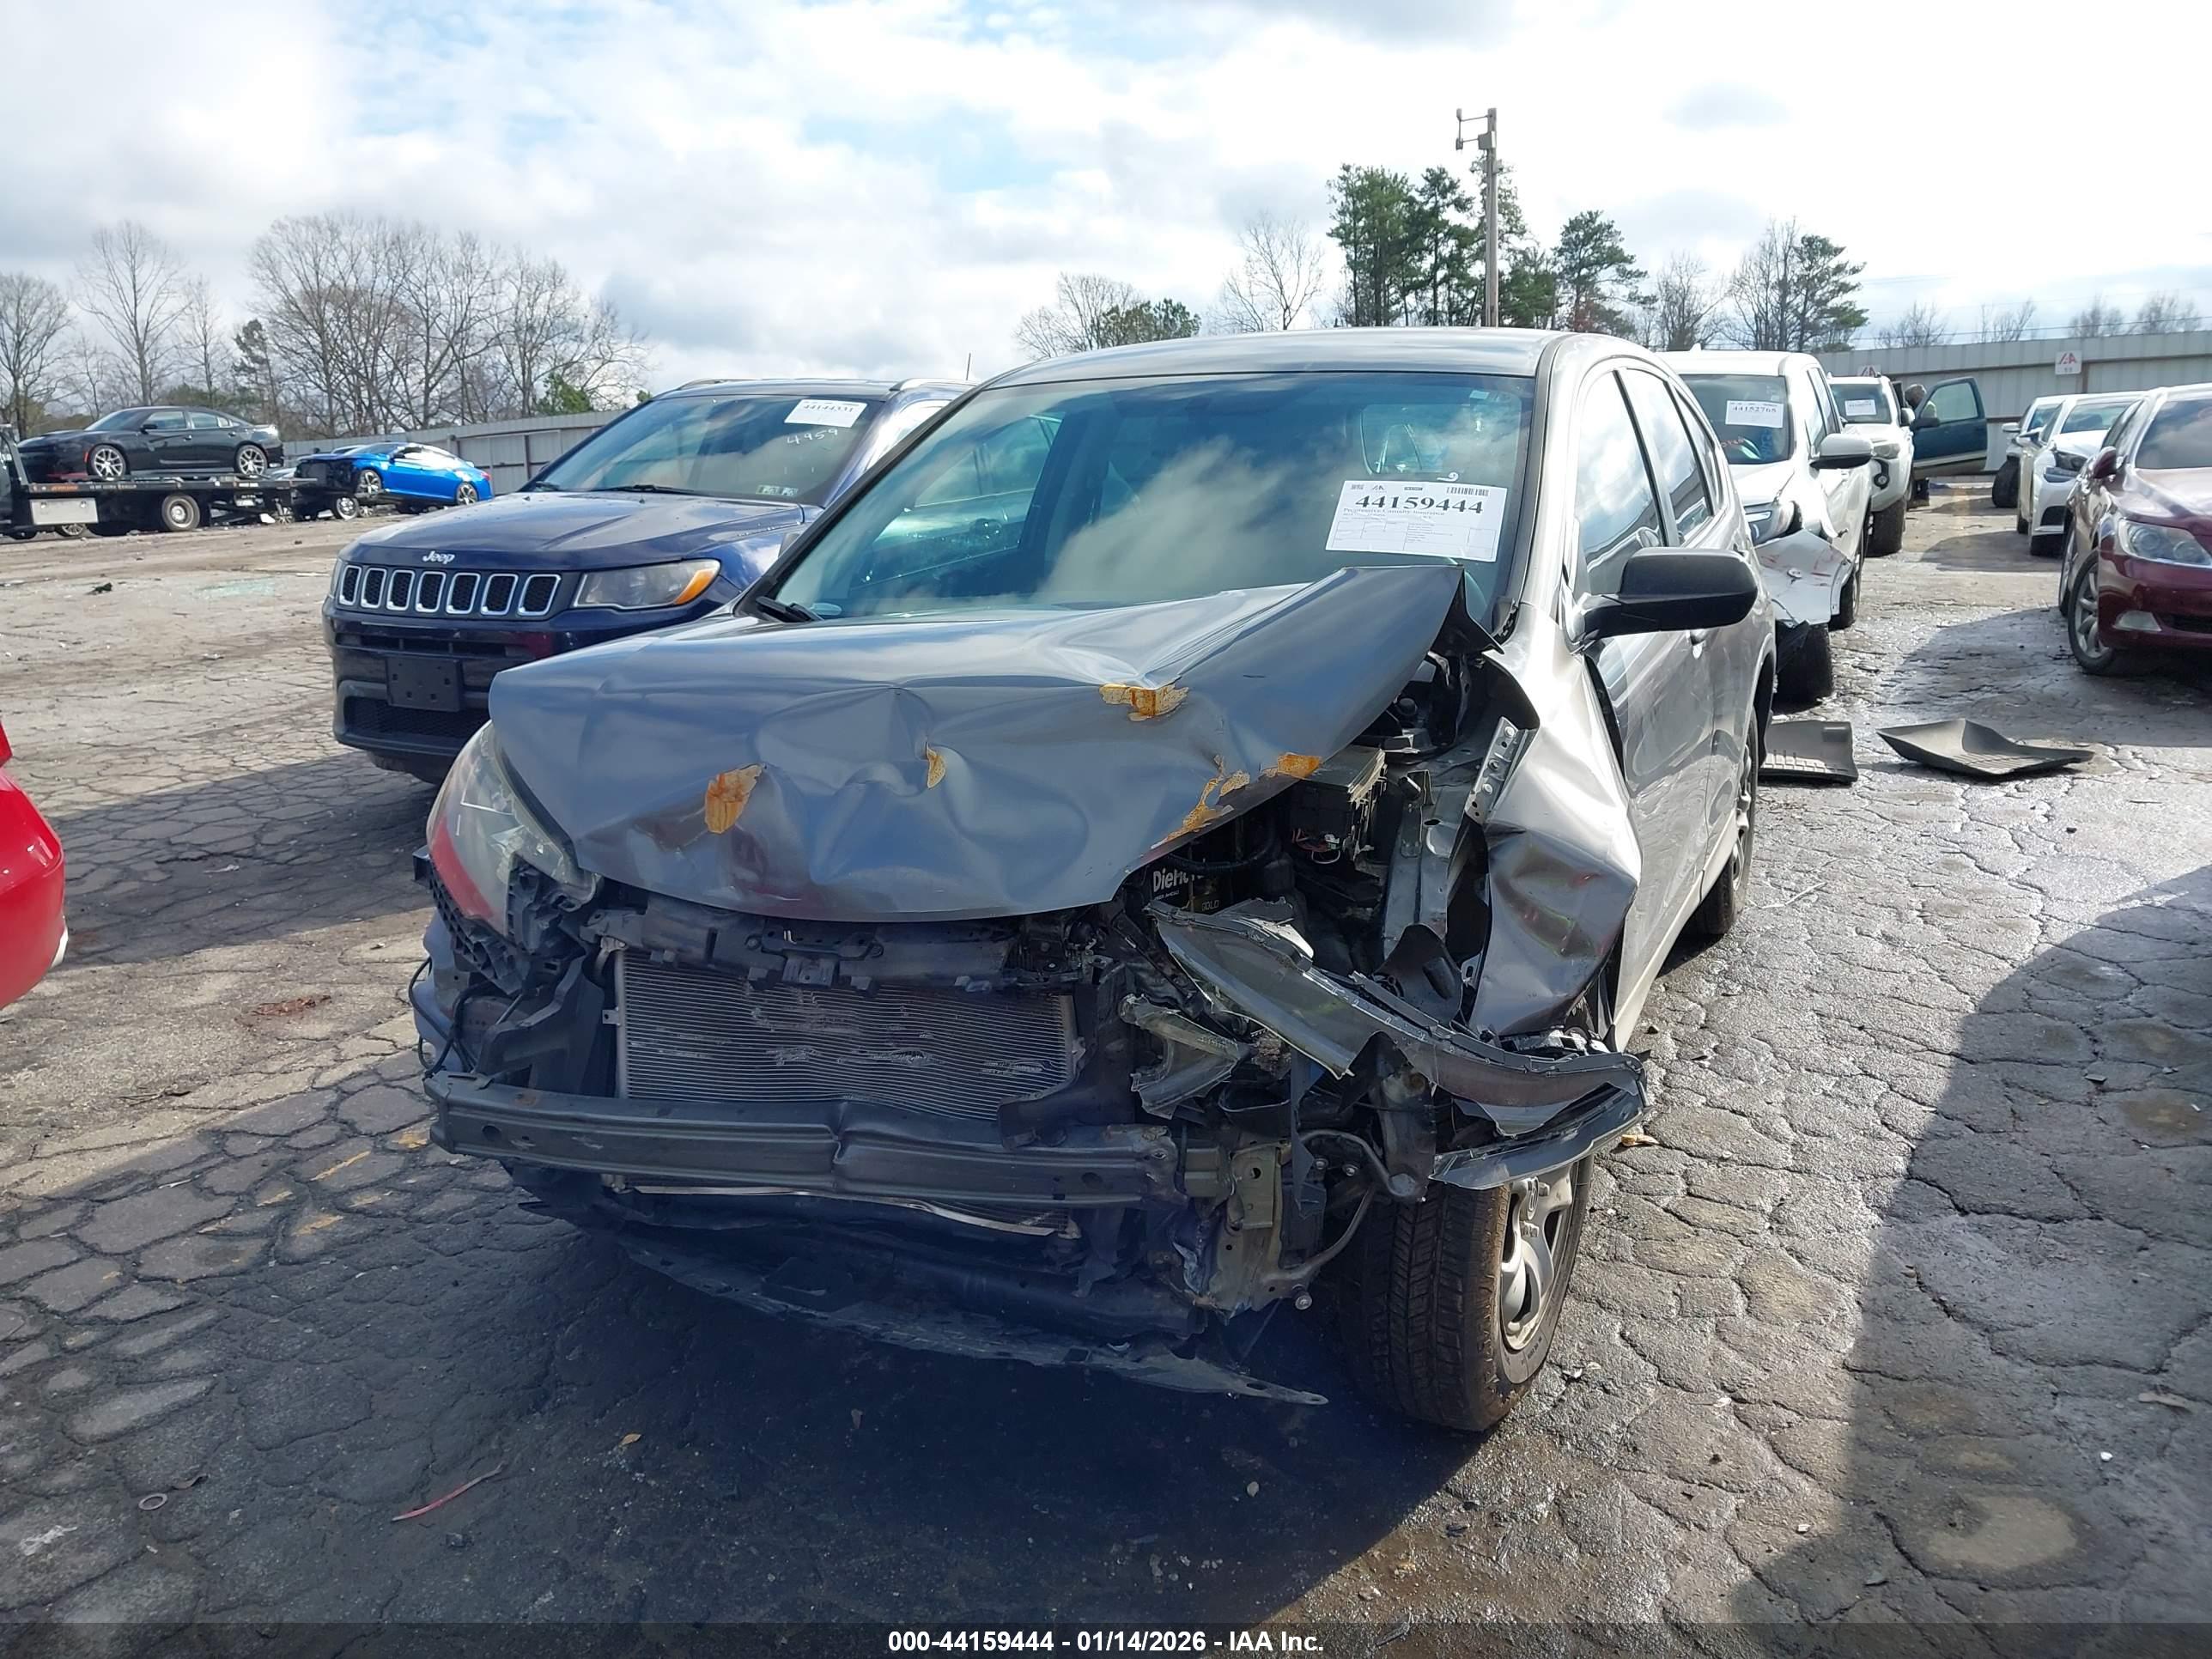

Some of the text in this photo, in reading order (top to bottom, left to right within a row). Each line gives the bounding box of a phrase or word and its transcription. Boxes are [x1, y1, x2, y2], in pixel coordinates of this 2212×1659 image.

[787, 428, 838, 444] 4959
[1355, 495, 1484, 514] 44159444
[422, 550, 455, 564] Jeep
